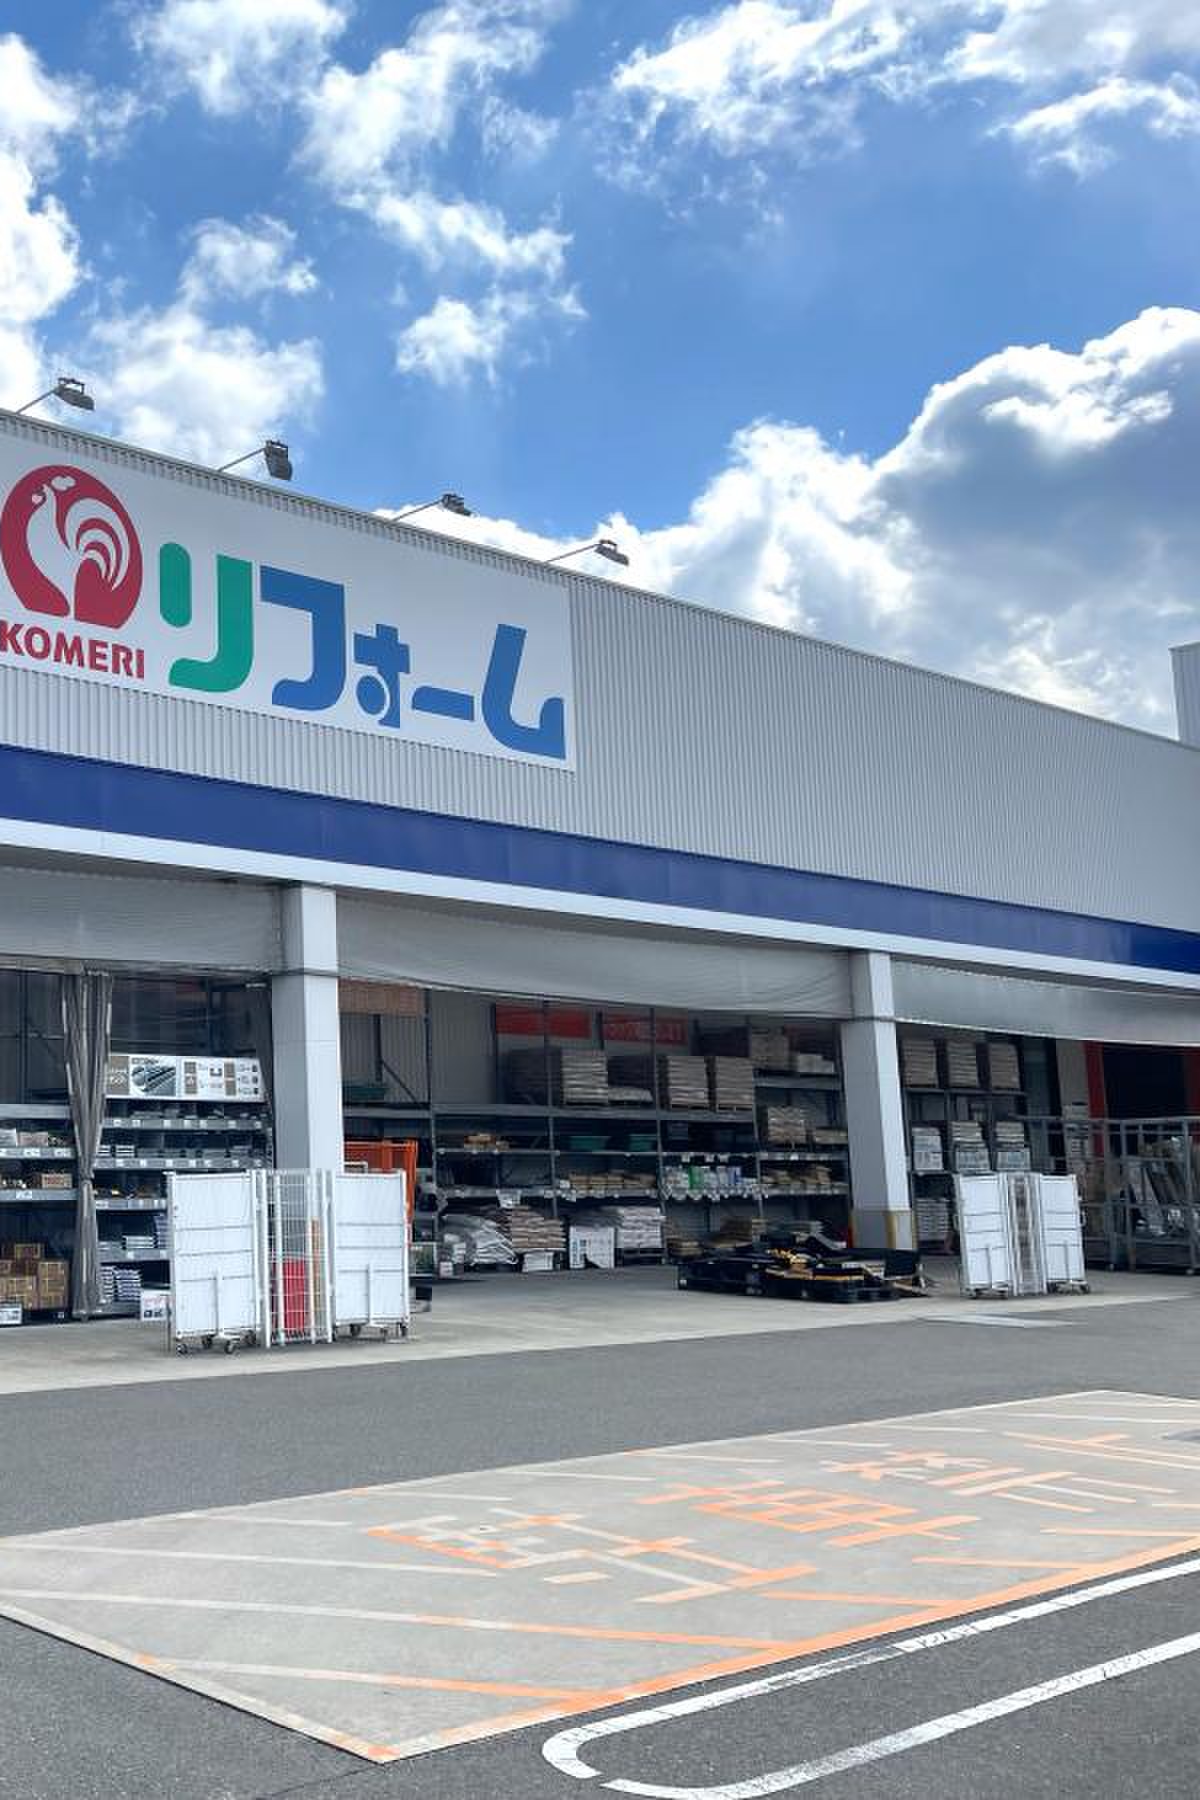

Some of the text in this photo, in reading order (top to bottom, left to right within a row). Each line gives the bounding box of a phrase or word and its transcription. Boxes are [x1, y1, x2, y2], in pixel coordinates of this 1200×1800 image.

[0, 619, 145, 680] KOMERI
[159, 541, 566, 760] リフォーム
